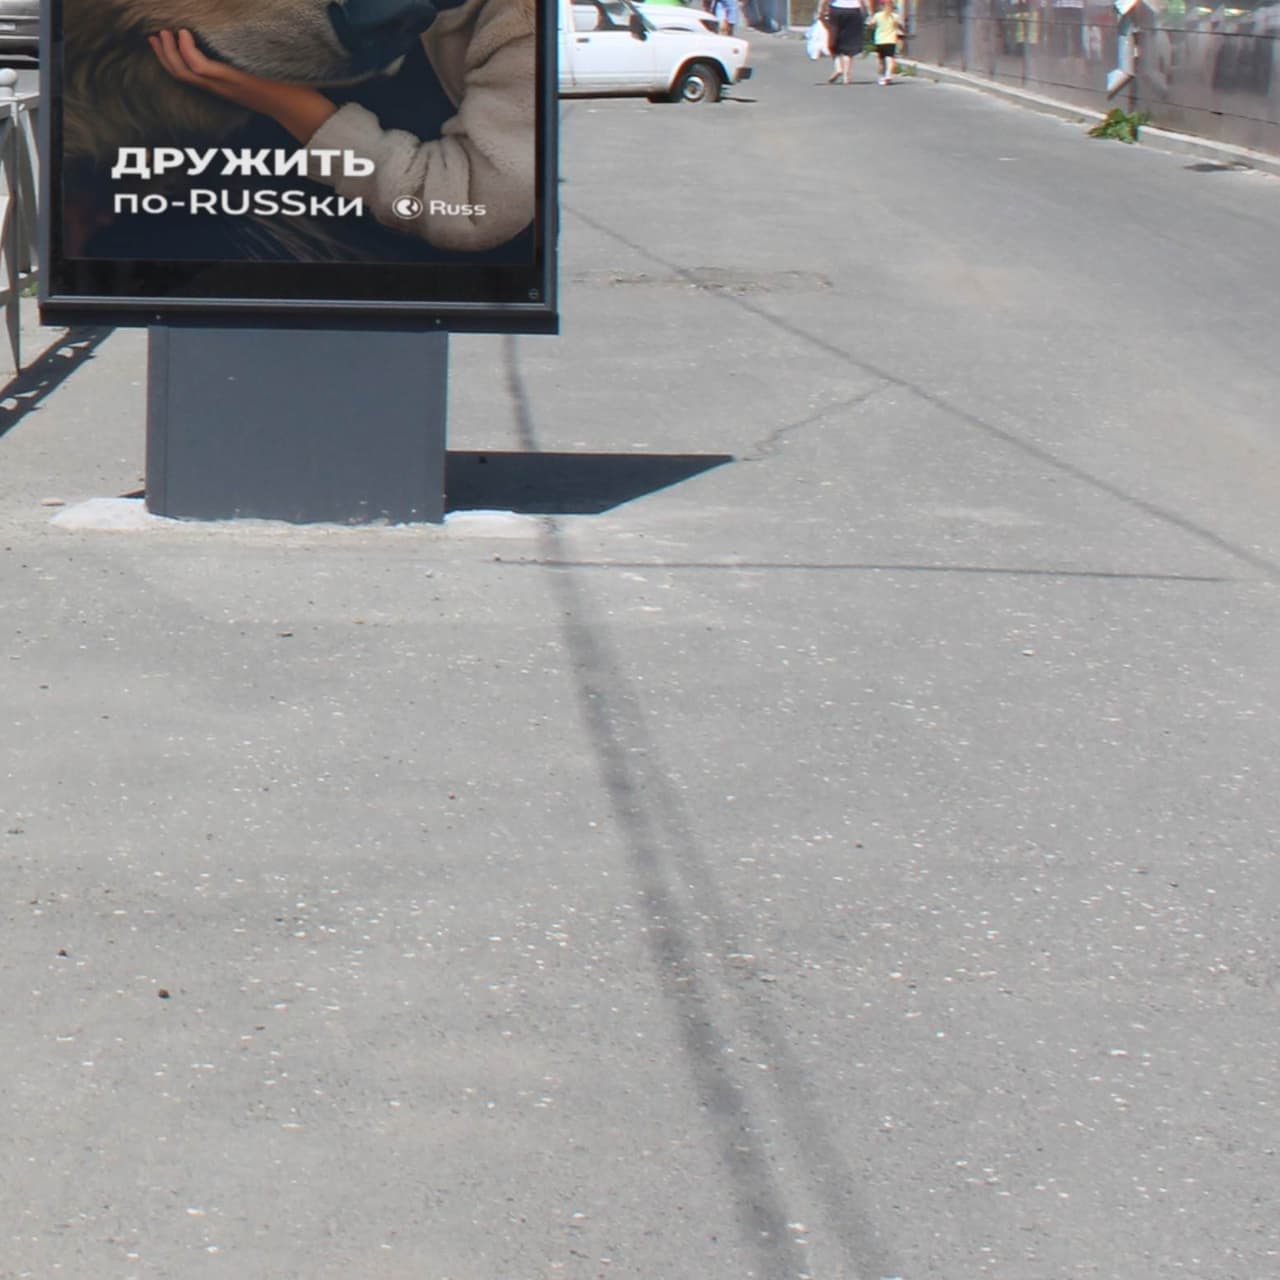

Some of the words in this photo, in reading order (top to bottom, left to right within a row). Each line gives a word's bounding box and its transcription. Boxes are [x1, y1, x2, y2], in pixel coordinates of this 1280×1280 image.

[111, 147, 375, 179] ДРУЖИТЬ
[113, 189, 364, 217] по-RUSSки
[429, 200, 487, 216] Russ
